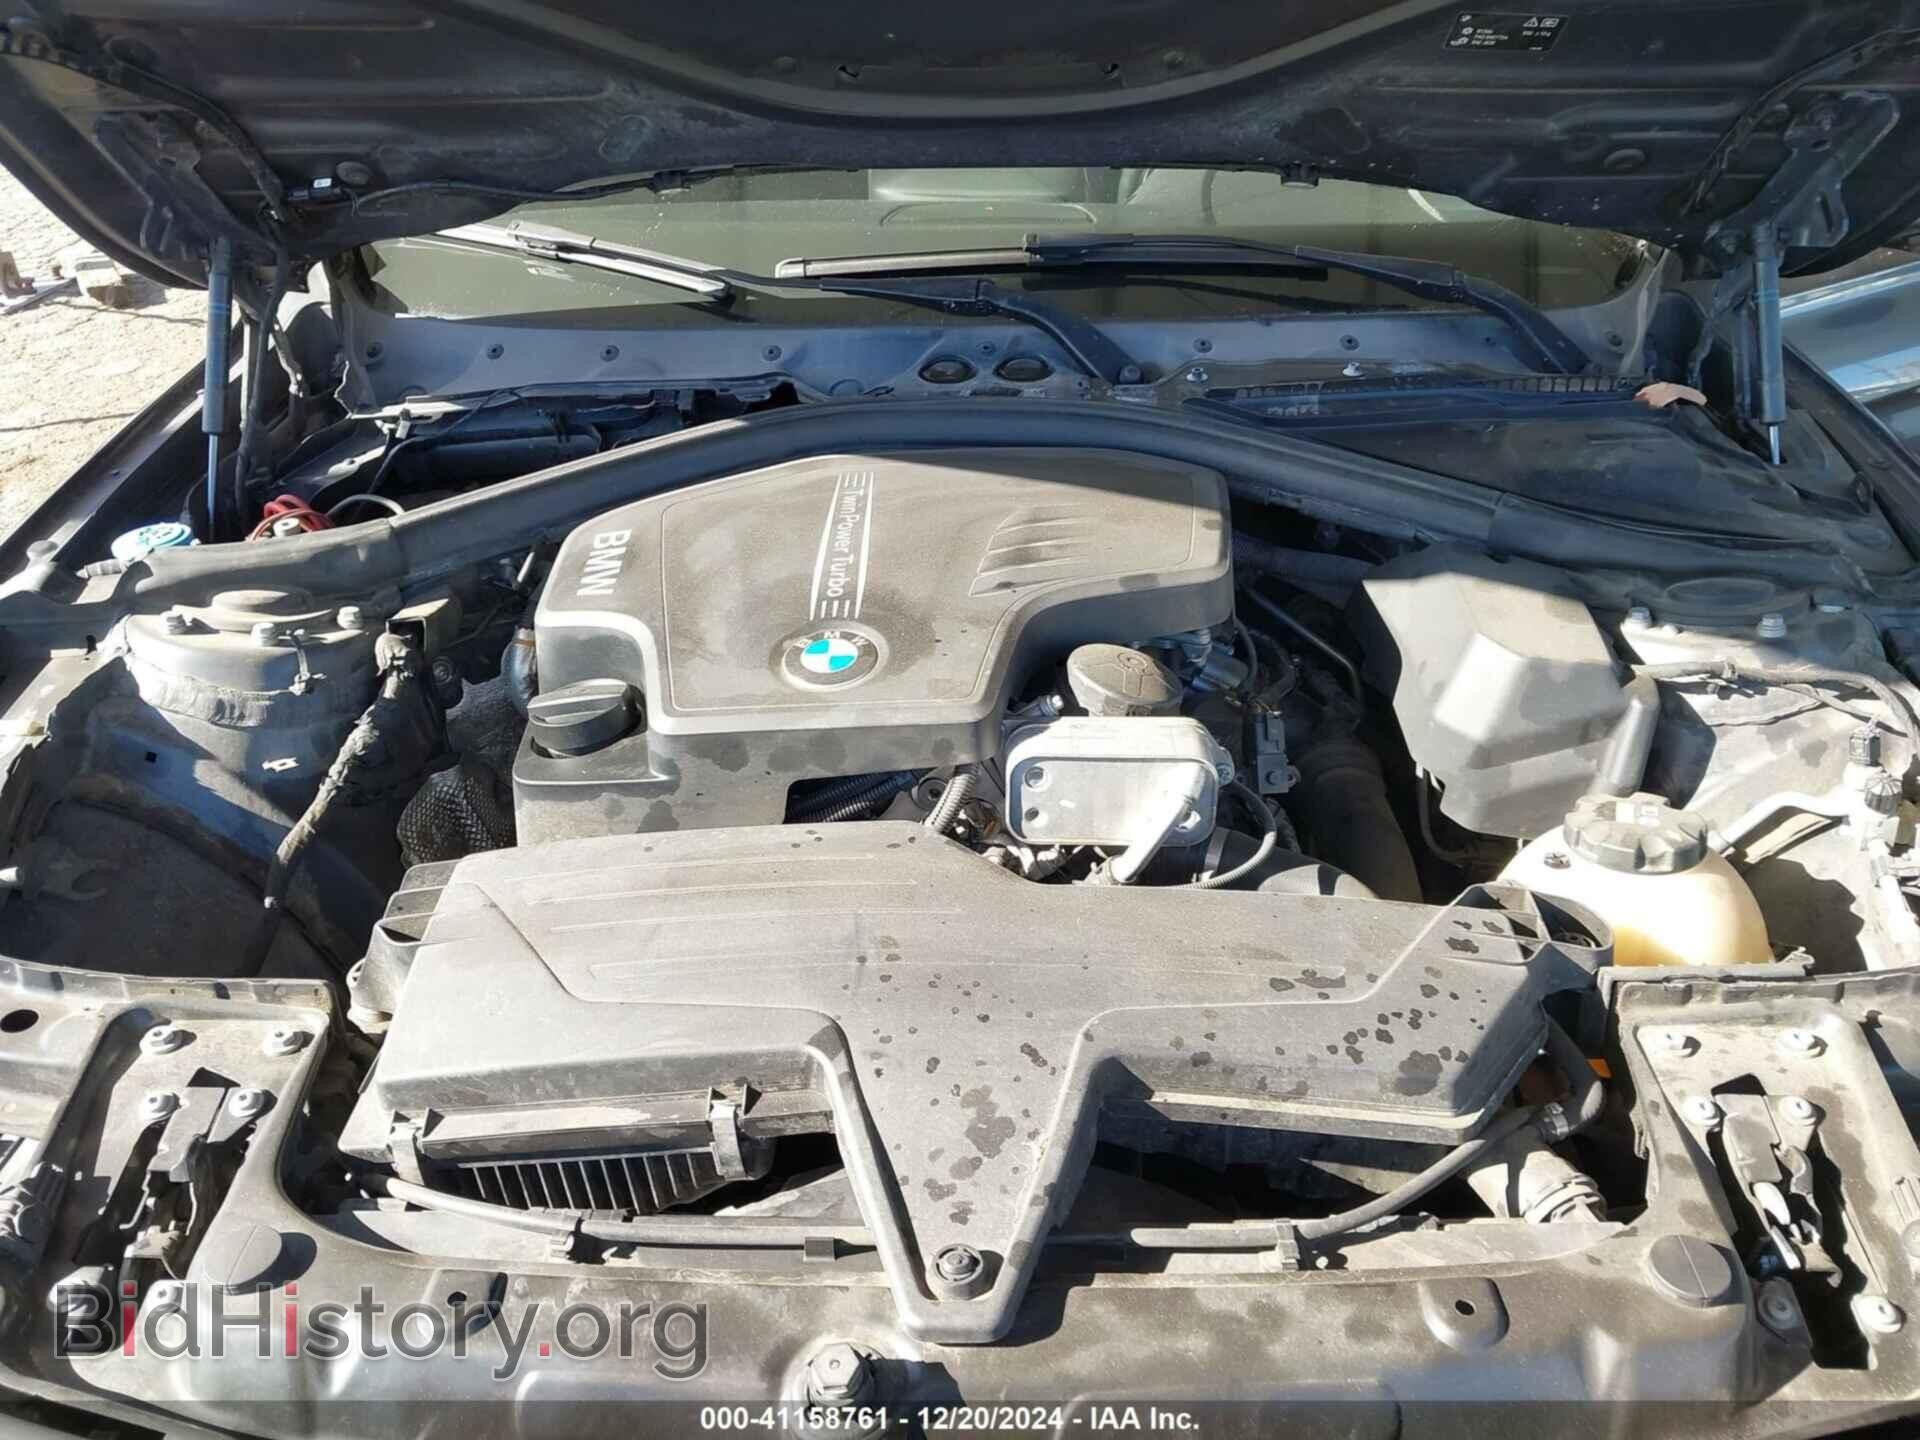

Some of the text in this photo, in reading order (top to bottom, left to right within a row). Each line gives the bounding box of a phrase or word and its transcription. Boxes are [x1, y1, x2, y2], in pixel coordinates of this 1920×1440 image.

[577, 529, 632, 595] BMW
[826, 488, 865, 598] TwinPower Turbo
